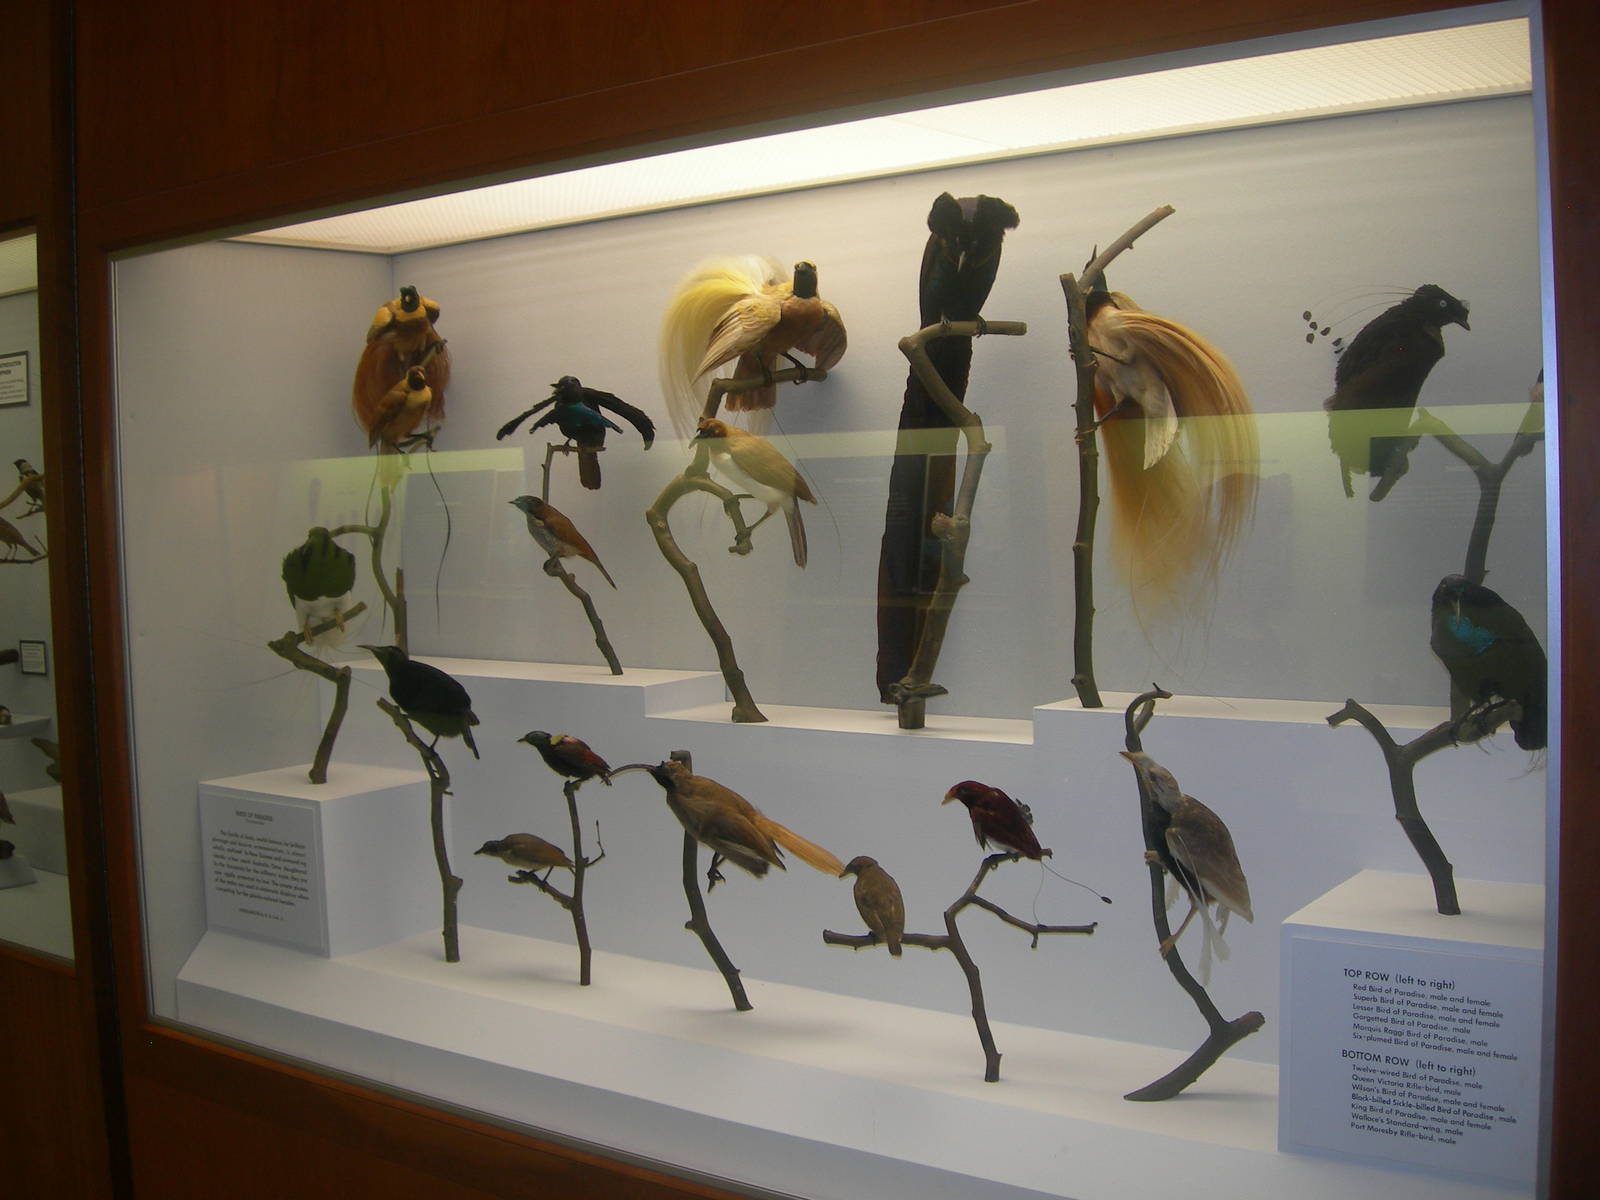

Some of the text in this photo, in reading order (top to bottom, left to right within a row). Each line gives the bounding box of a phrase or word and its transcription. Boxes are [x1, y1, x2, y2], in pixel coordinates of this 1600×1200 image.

[1344, 969, 1362, 977] TOP
[1366, 972, 1389, 981] ROW
[1395, 974, 1414, 984] (left
[1430, 980, 1455, 990] right)
[1353, 994, 1378, 1002] Superb
[1479, 1009, 1503, 1018] female
[1467, 998, 1491, 1006] female
[1476, 1018, 1500, 1027] female
[1384, 1027, 1404, 1036] Raggi
[1493, 1050, 1517, 1060] female
[1342, 1050, 1381, 1062] BOTTOM
[1385, 1056, 1409, 1066] ROW
[1416, 1060, 1434, 1070] (left
[1450, 1066, 1476, 1077] right)
[1352, 1074, 1374, 1083] Queen
[1378, 1079, 1404, 1087] Victoria
[1352, 1084, 1379, 1093] Wilson's
[1480, 1104, 1504, 1112] female
[1352, 1103, 1367, 1112] King
[1467, 1120, 1491, 1130] female
[1352, 1113, 1383, 1123] Wallace's
[1367, 1126, 1397, 1136] Moresby
